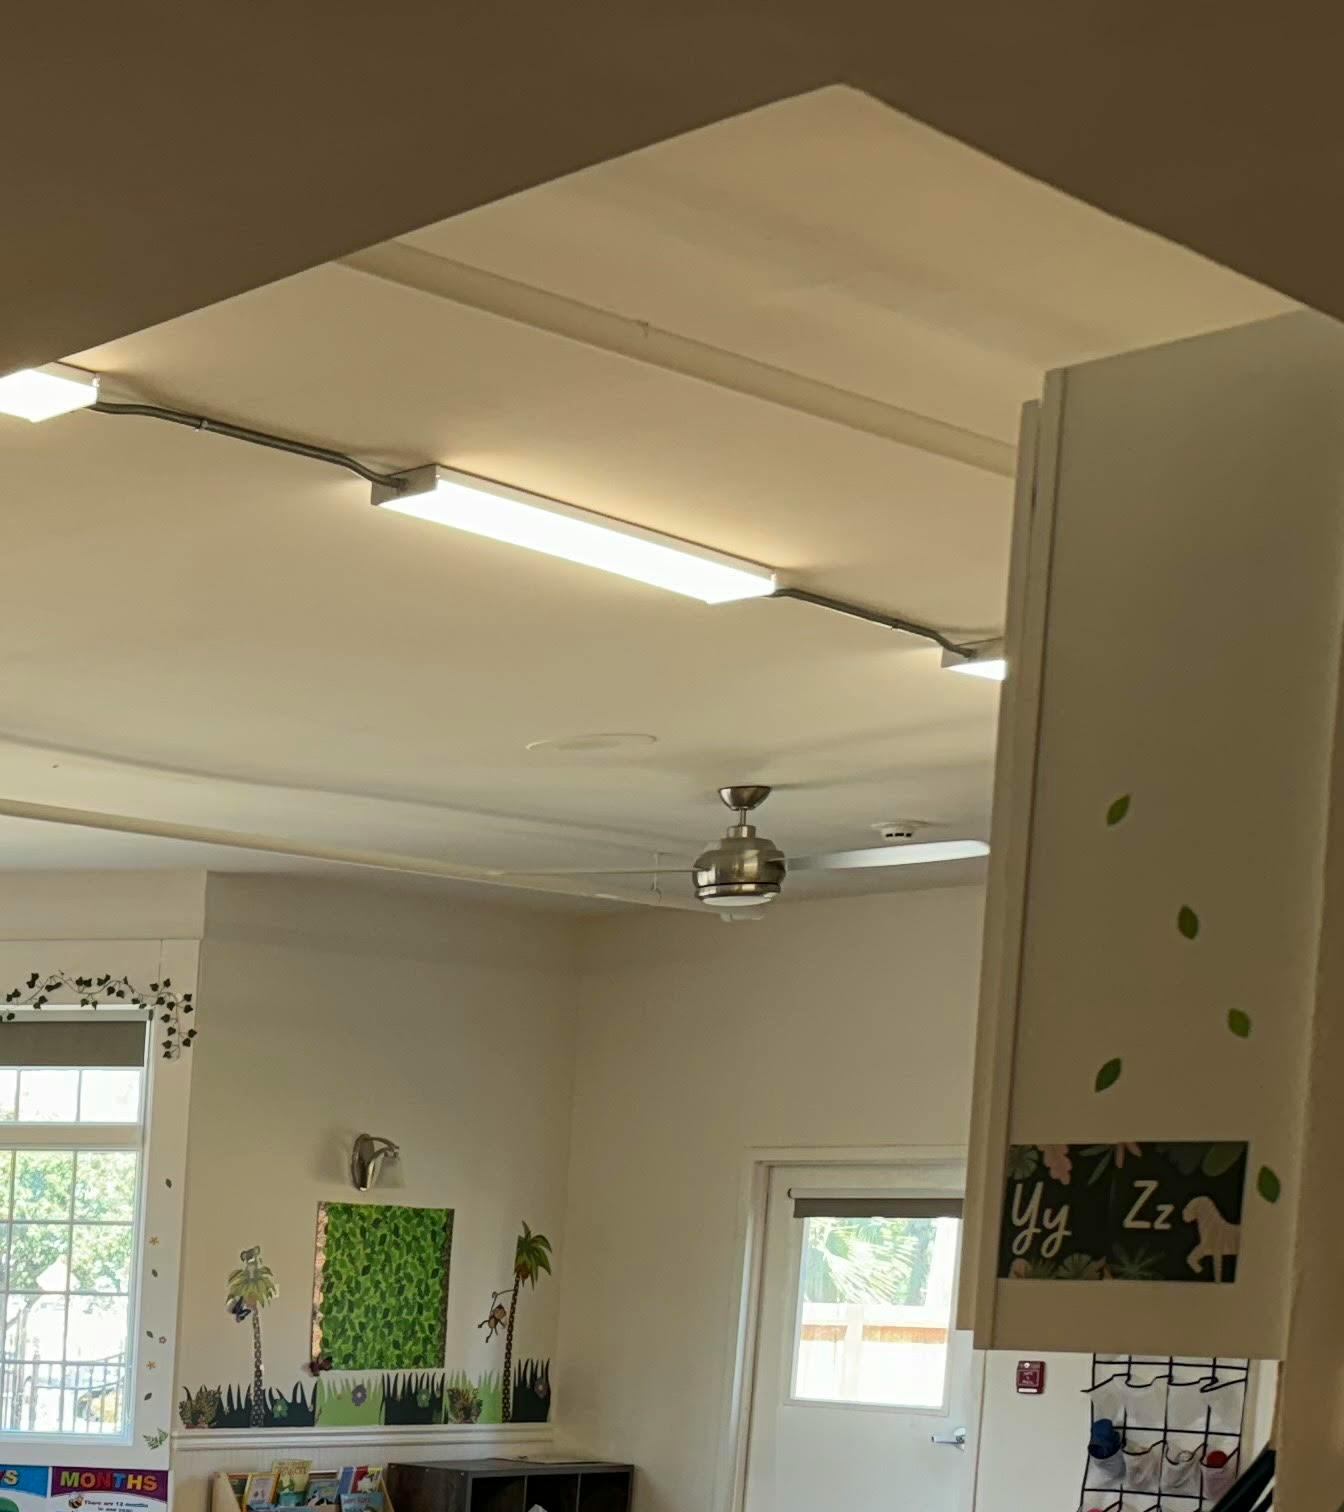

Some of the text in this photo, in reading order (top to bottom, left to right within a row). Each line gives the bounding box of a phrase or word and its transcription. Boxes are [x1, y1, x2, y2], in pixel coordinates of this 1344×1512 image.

[1012, 1182, 1072, 1259] Yy
[1123, 1180, 1174, 1231] Zz
[60, 1471, 159, 1492] MONTHS
